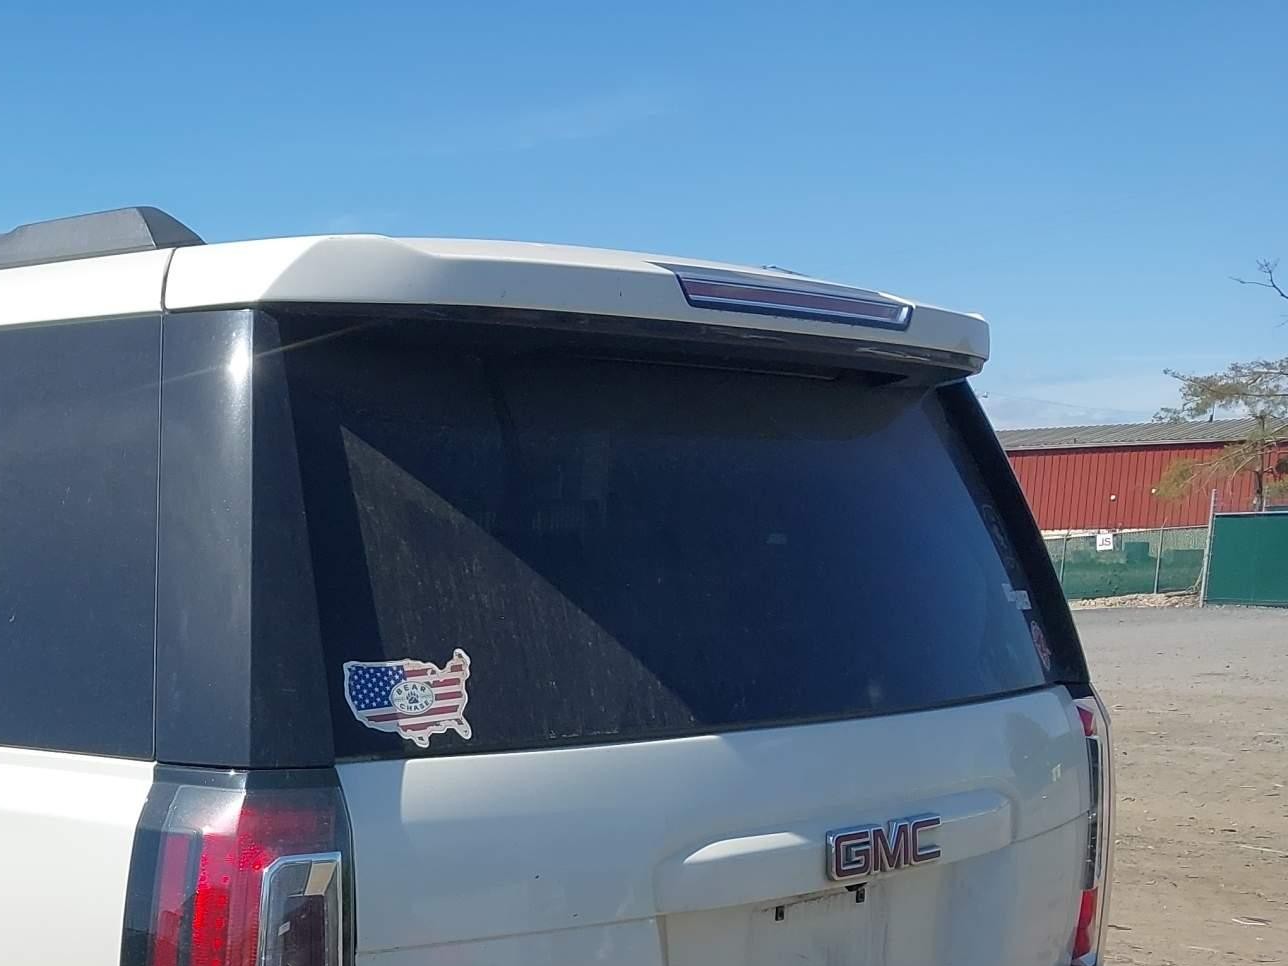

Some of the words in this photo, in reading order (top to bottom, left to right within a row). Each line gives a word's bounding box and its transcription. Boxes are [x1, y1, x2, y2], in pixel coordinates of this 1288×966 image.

[395, 683, 427, 696] BEAR
[399, 699, 430, 711] CHASE
[826, 812, 942, 882] GMC
